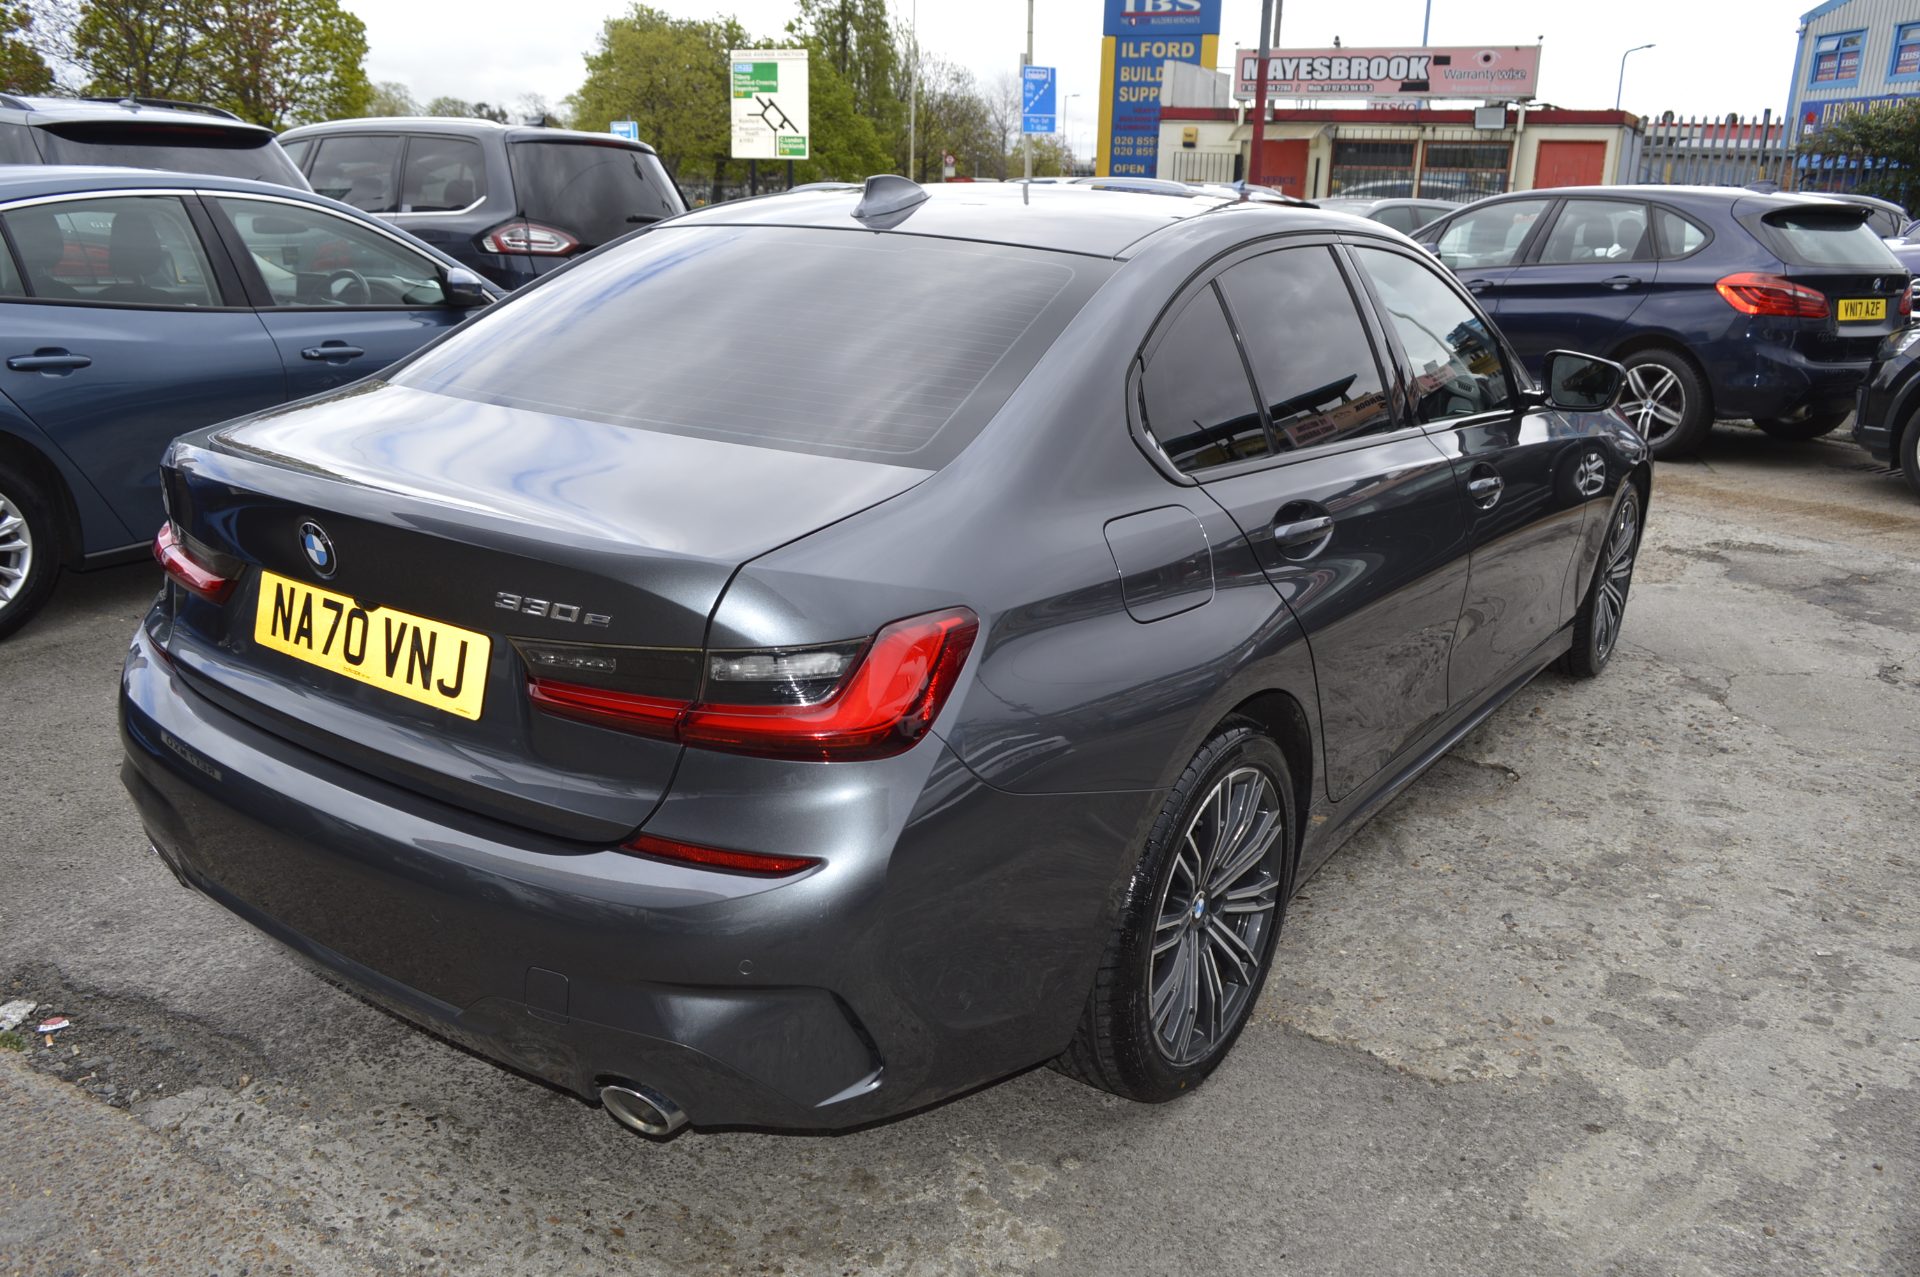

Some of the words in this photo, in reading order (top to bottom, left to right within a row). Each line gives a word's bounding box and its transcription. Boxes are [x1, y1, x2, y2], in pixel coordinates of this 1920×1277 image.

[1121, 41, 1195, 58] ILFORD
[1242, 56, 1431, 81] MAYESBROOK
[1114, 164, 1145, 174] OPEN
[1844, 301, 1863, 317] VN17
[1865, 301, 1881, 316] AZF
[271, 582, 369, 666] NA70
[384, 616, 468, 699] VNJ
